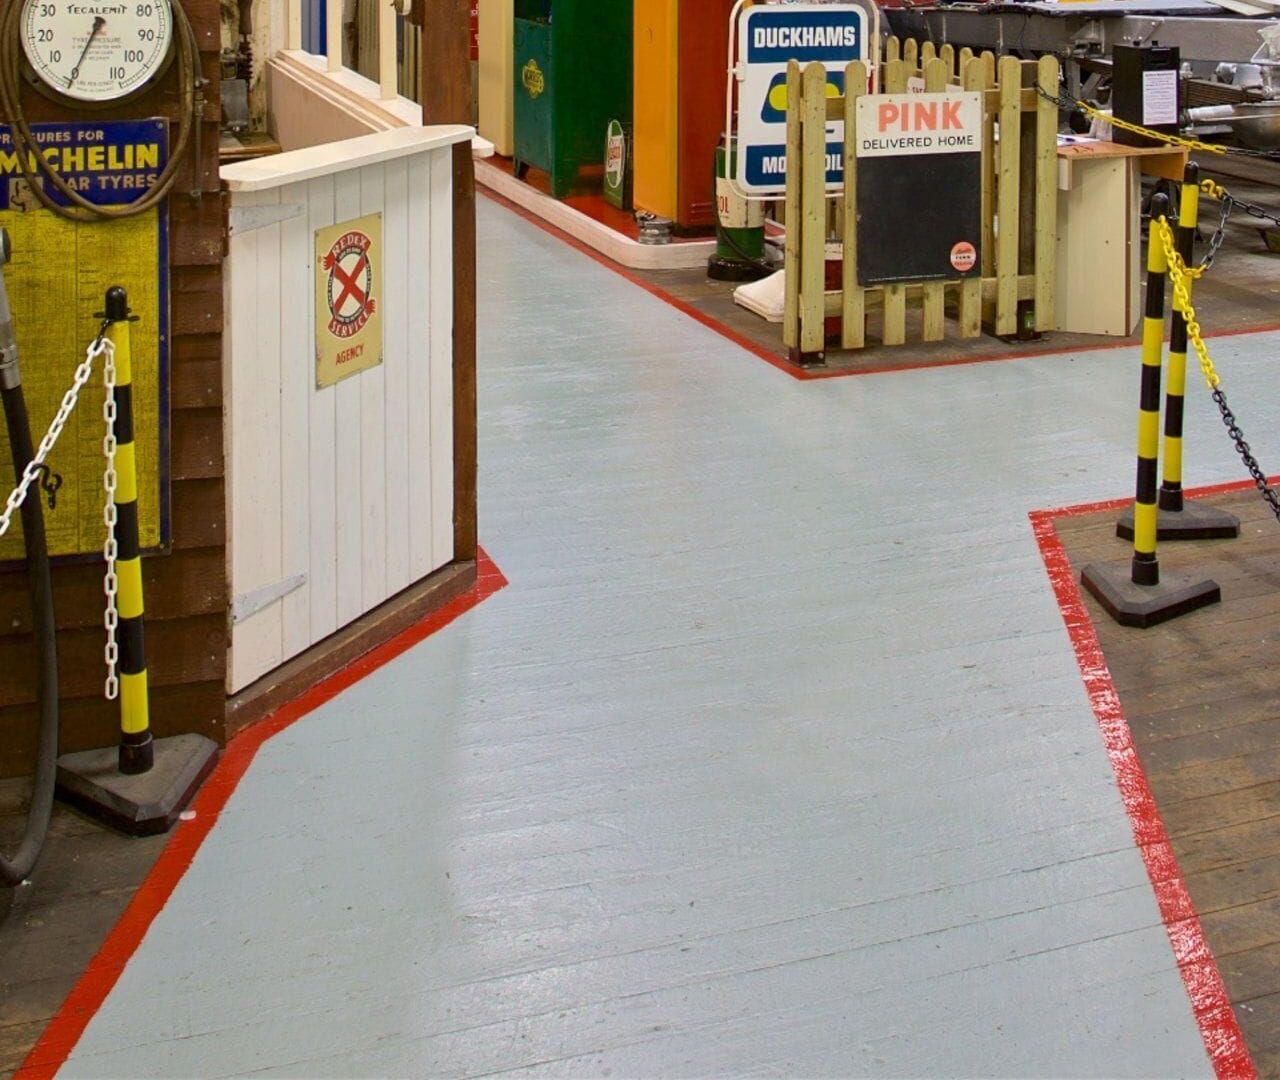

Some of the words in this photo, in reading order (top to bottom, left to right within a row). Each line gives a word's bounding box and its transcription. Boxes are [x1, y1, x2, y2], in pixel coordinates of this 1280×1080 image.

[40, 4, 56, 17] 30
[67, 4, 128, 14] TECALEMIT
[136, 4, 152, 17] 80
[38, 30, 53, 42] 20
[138, 30, 154, 42] 90
[754, 26, 856, 49] DUCKHAMS
[49, 51, 61, 63] 10
[123, 50, 144, 63] 100
[109, 67, 126, 79] 110
[878, 101, 964, 132] PINK
[78, 130, 104, 141] FOR
[863, 136, 932, 151] DELIVERED
[938, 134, 974, 148] HOME
[98, 173, 158, 190] TYRES
[332, 233, 368, 257] REDEX
[331, 312, 369, 337] SERVICE
[335, 343, 365, 365] AGENCY
